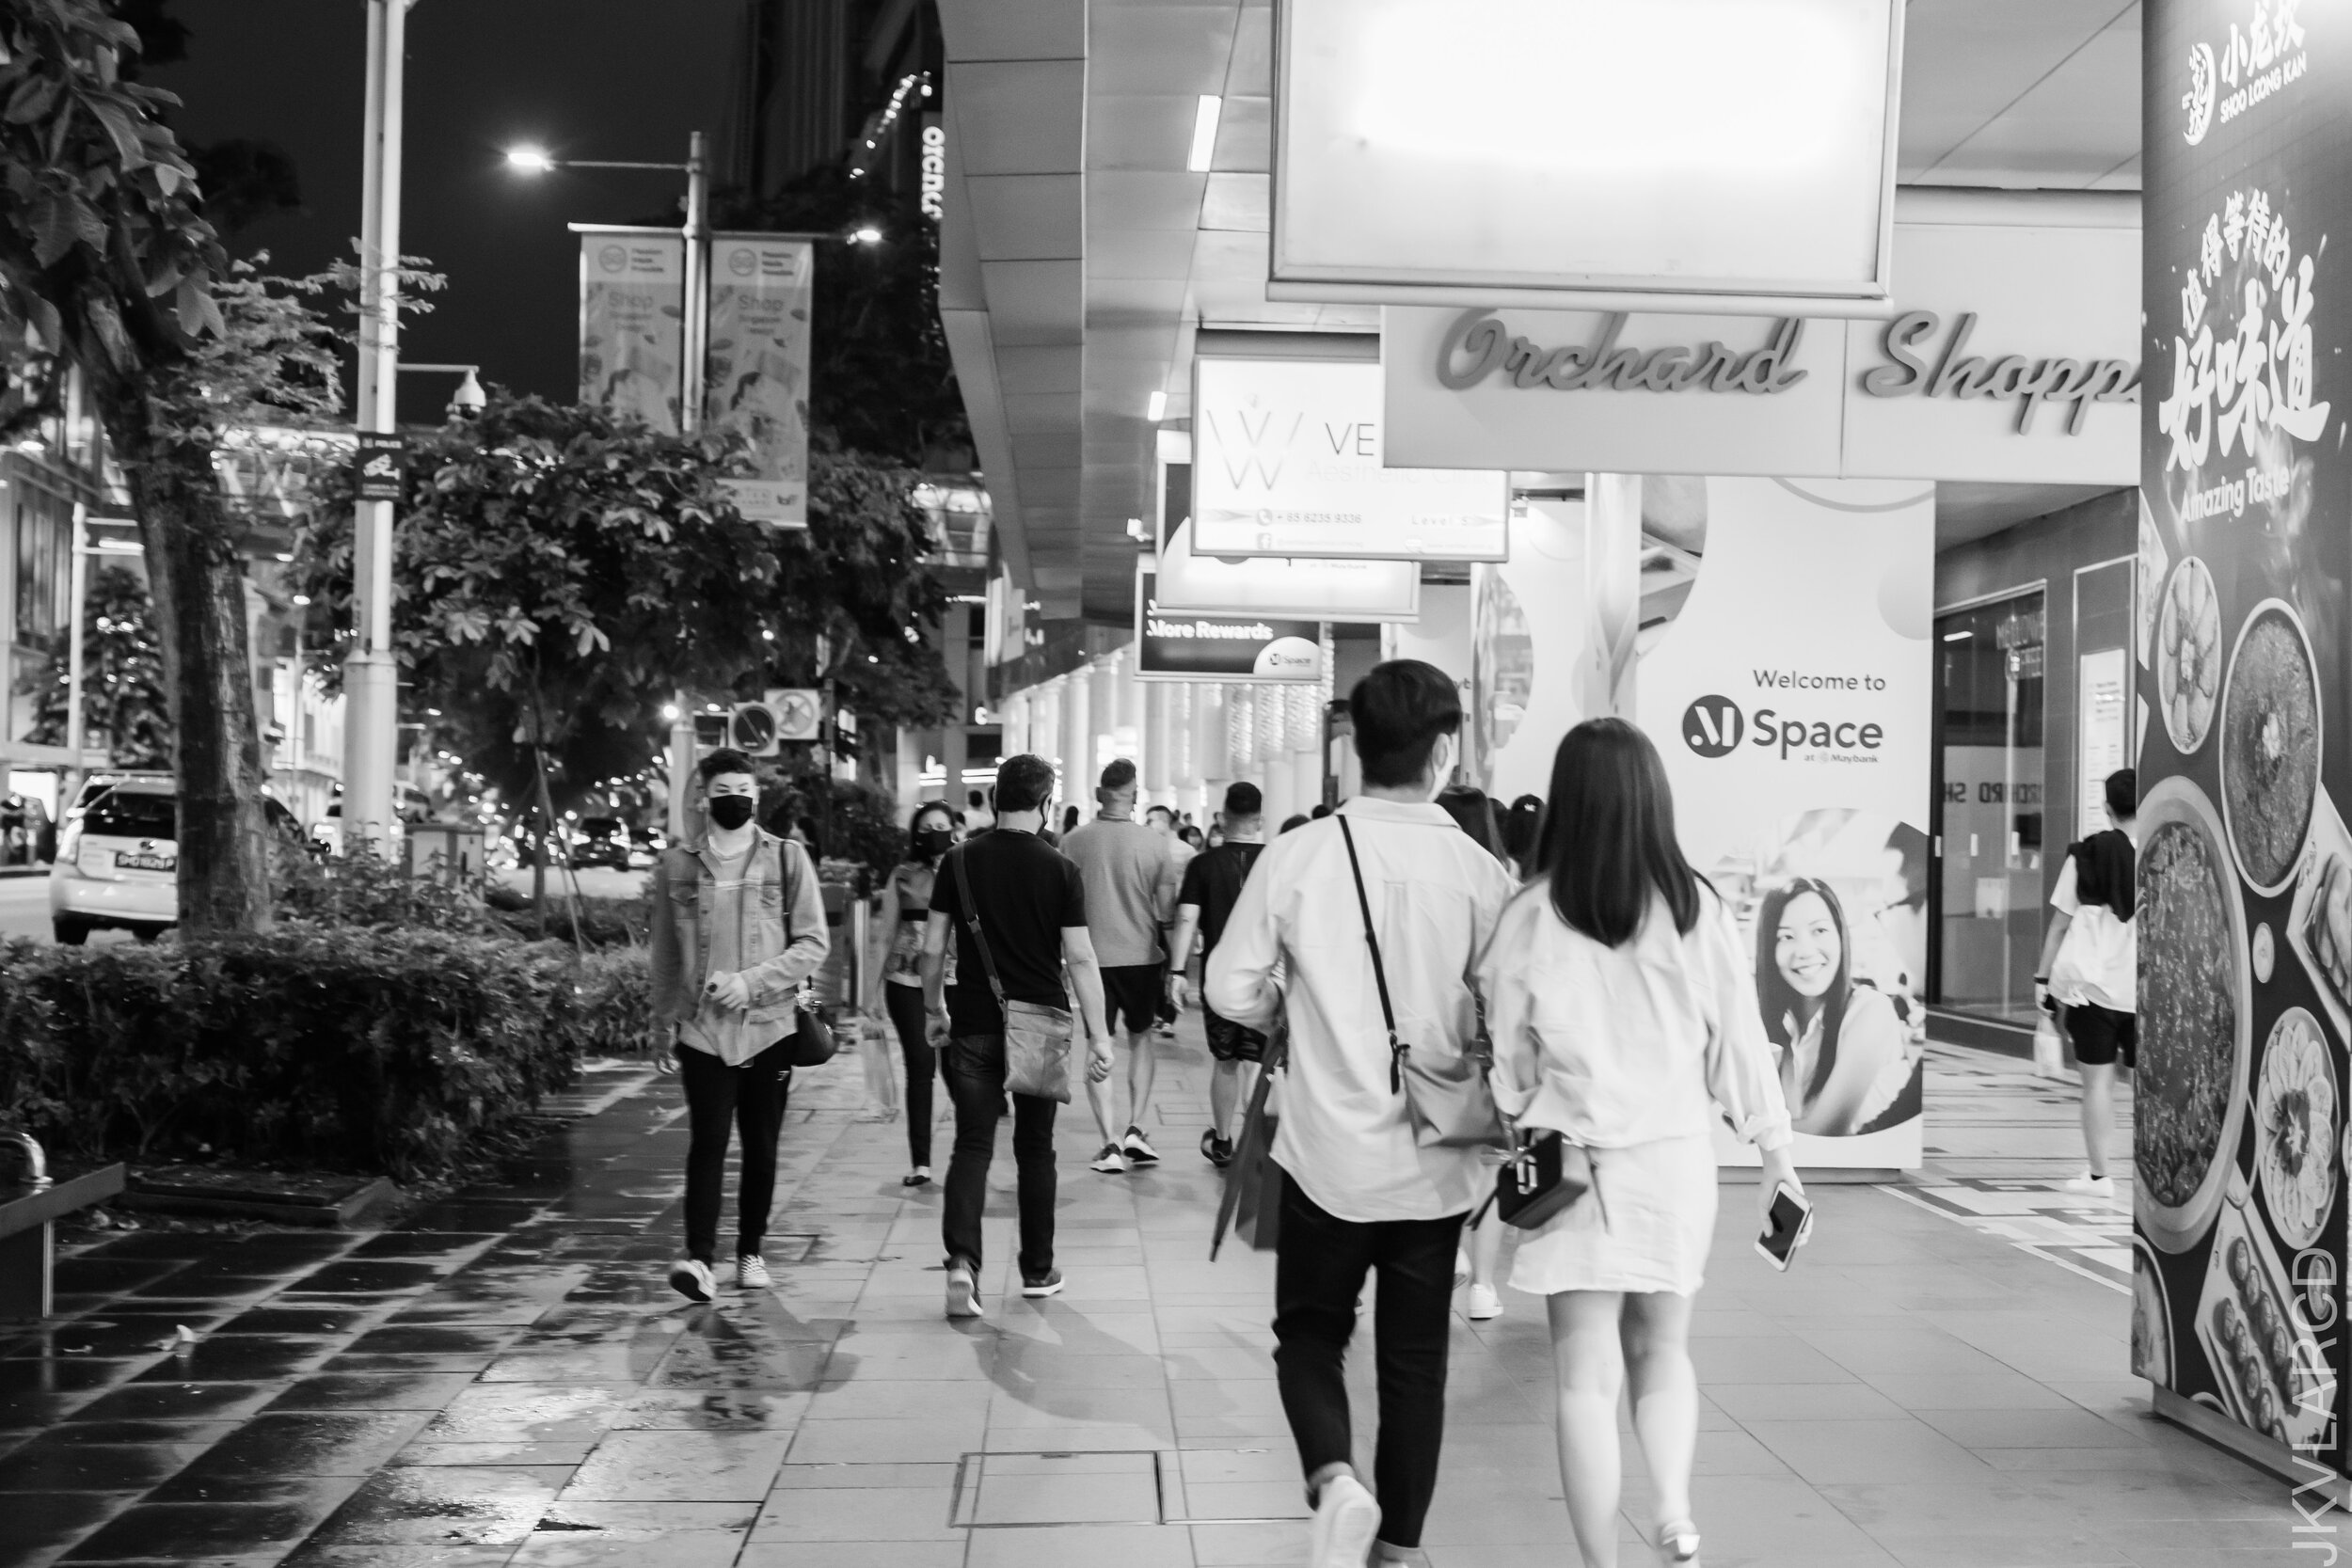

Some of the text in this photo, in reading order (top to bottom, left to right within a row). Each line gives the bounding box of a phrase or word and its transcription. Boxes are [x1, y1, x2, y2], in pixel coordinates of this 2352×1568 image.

[2219, 87, 2248, 123] SHOO
[2248, 66, 2282, 106] LOONG
[2282, 50, 2307, 85] KAN
[1436, 309, 2142, 436] Orchard Shopp
[2159, 254, 2331, 472] 好味道
[1411, 515, 1453, 526] Level
[2180, 467, 2291, 523] Amazing Taste
[1195, 620, 1274, 641] Rewards
[1753, 669, 1886, 691] Welcome to
[1751, 708, 1883, 761] Space
